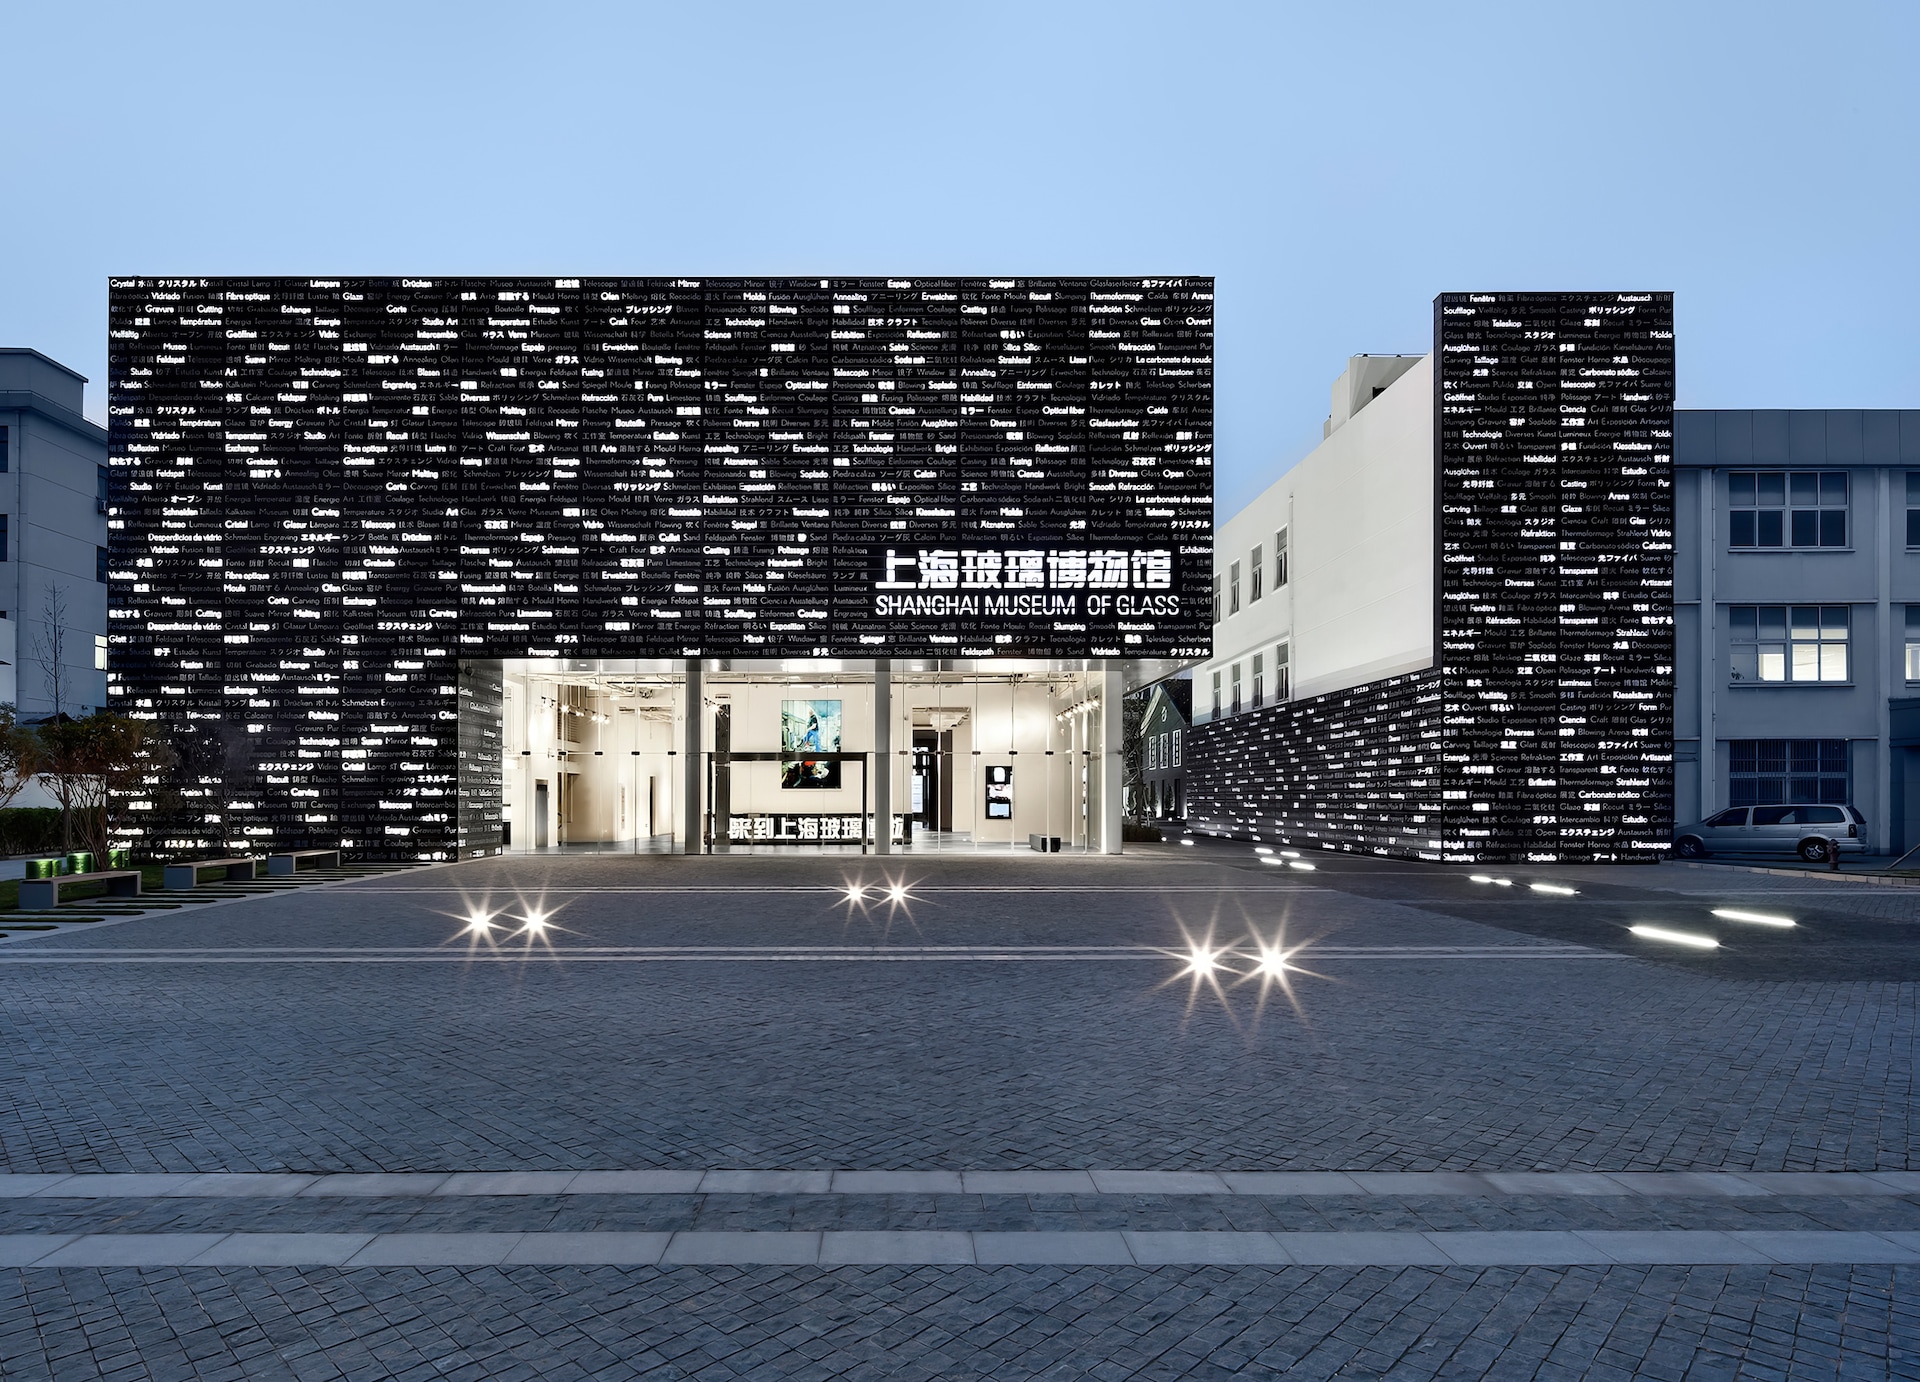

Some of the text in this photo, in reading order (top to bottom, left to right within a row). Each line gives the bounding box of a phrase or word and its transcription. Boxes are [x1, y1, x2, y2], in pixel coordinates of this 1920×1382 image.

[875, 549, 1172, 589] 上海玻璃博物馆
[875, 595, 1180, 616] SHANGHAI MUSEUM OF GLASS
